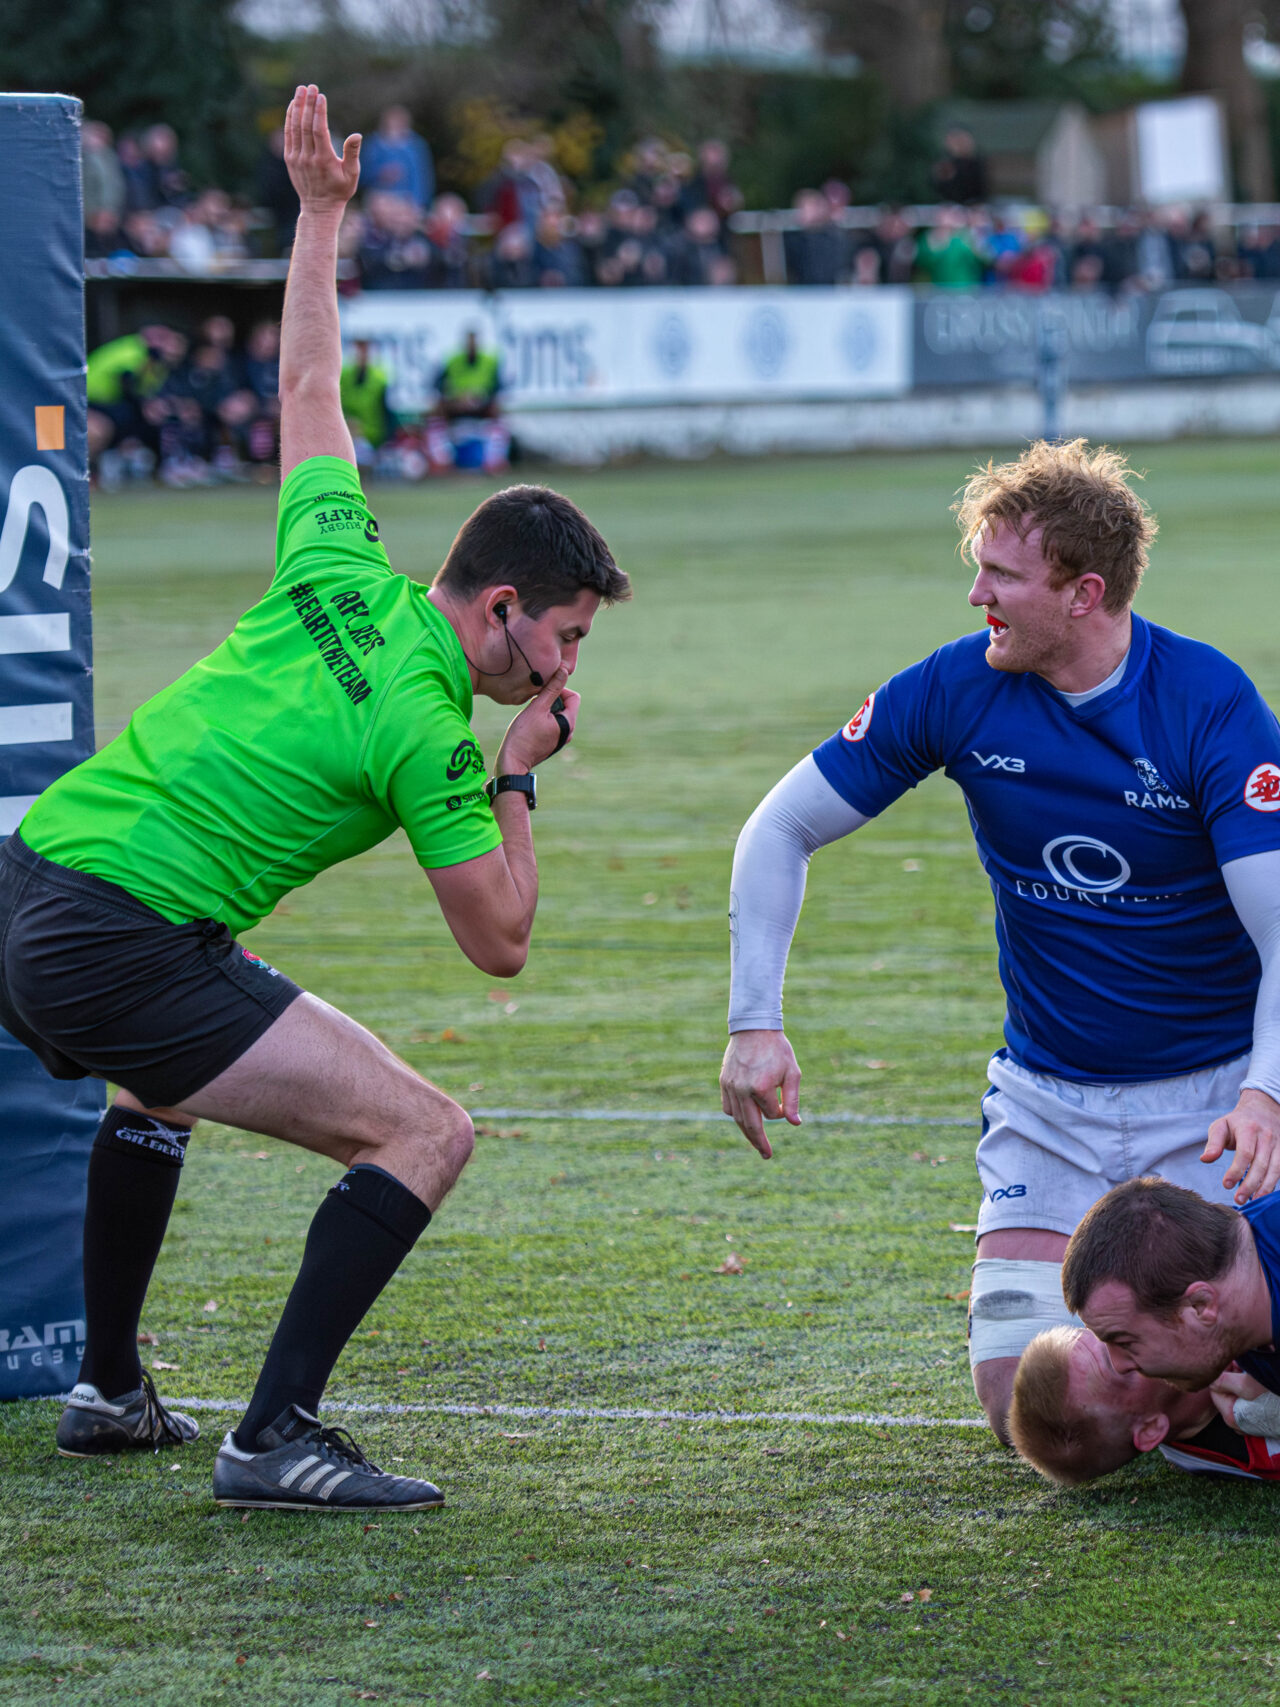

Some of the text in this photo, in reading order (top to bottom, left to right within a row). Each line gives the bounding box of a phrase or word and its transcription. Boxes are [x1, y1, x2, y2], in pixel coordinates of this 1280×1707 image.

[315, 509, 365, 525] SAFE
[320, 522, 362, 535] RUGBY
[971, 751, 1026, 773] VX3
[1124, 791, 1190, 809] RAMS
